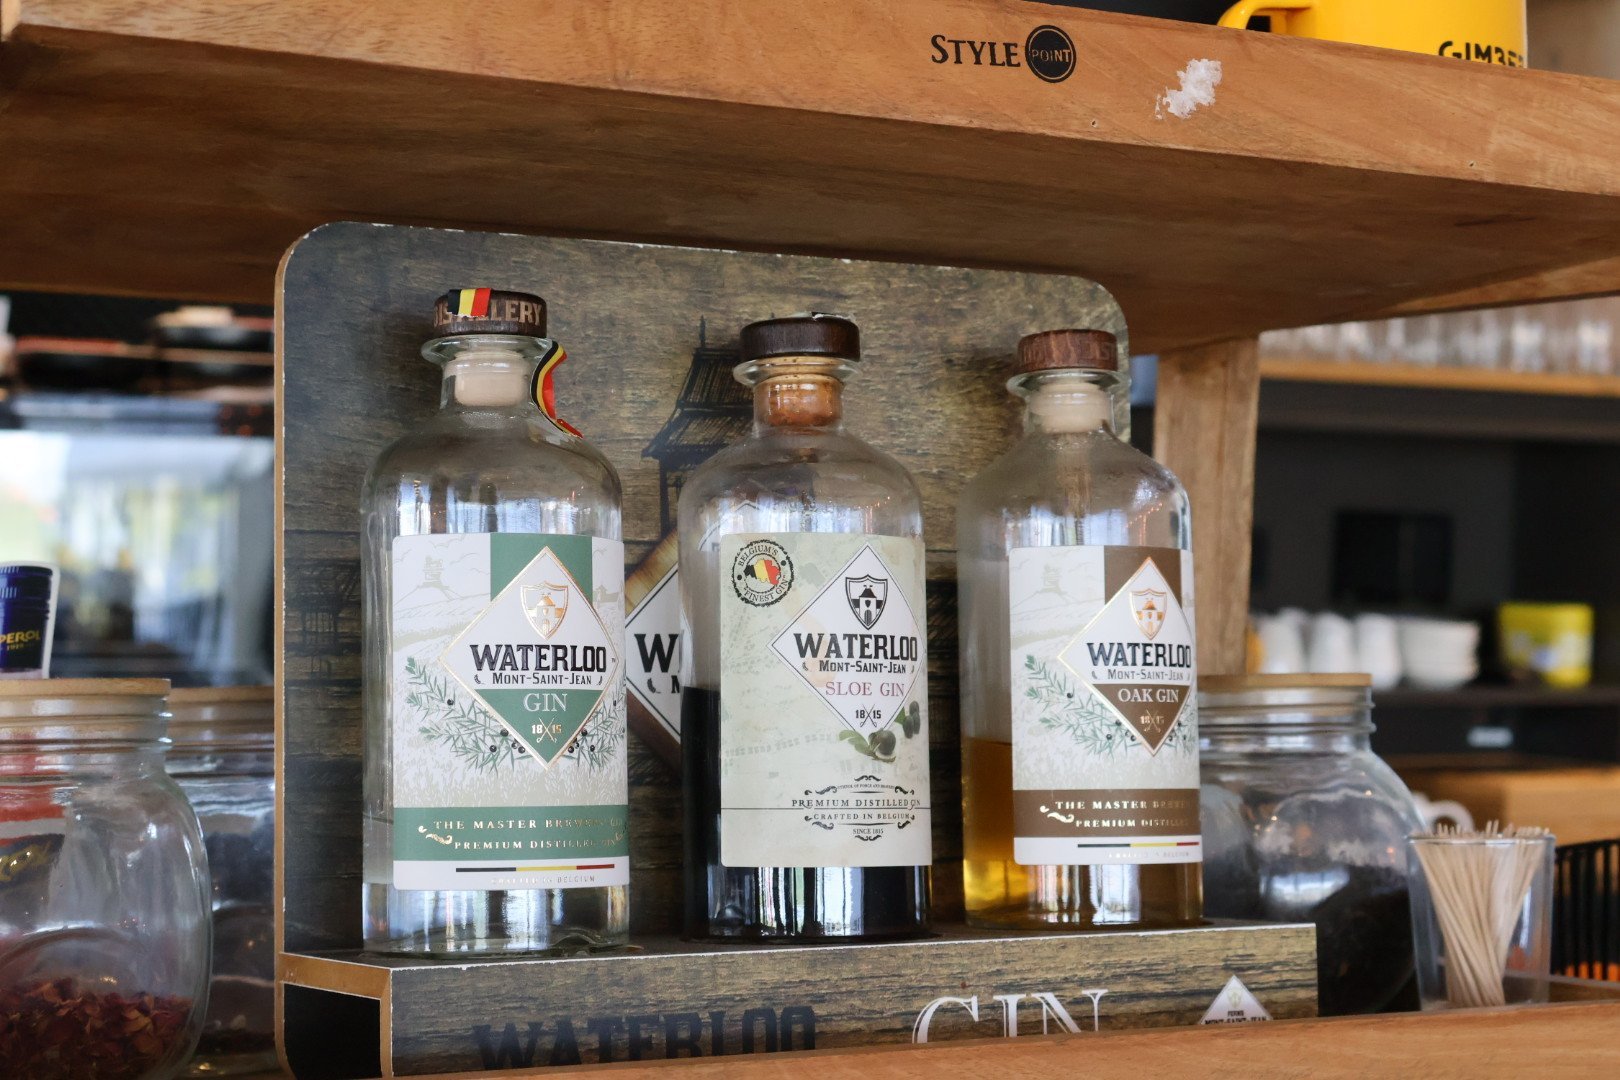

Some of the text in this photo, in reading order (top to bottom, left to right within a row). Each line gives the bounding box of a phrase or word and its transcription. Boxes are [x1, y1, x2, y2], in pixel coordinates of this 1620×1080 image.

[931, 34, 1071, 67] STYLE POINT
[738, 545, 779, 566] BELGIUM'S
[793, 632, 918, 661] WATERLOO
[470, 644, 606, 673] WATERLOO
[1086, 642, 1192, 668] WATERLOO
[819, 660, 906, 674] MONT-SAINT-JEAN
[492, 672, 592, 685] MONT-SAINT-JEAN
[1107, 668, 1184, 681] MONT-SAINT-JEAN
[825, 681, 905, 697] SLOE GIN
[1118, 688, 1180, 703] OAK GIN
[523, 692, 568, 712] GIN
[791, 799, 849, 809] PREMIUM
[855, 799, 909, 808] DISTILLED
[1055, 801, 1086, 810] THE
[1092, 801, 1147, 810] MASTER
[433, 820, 465, 830] THE
[473, 819, 537, 830] MASTER
[1075, 819, 1136, 828] PREMIUM
[454, 840, 523, 850] PREMIUM
